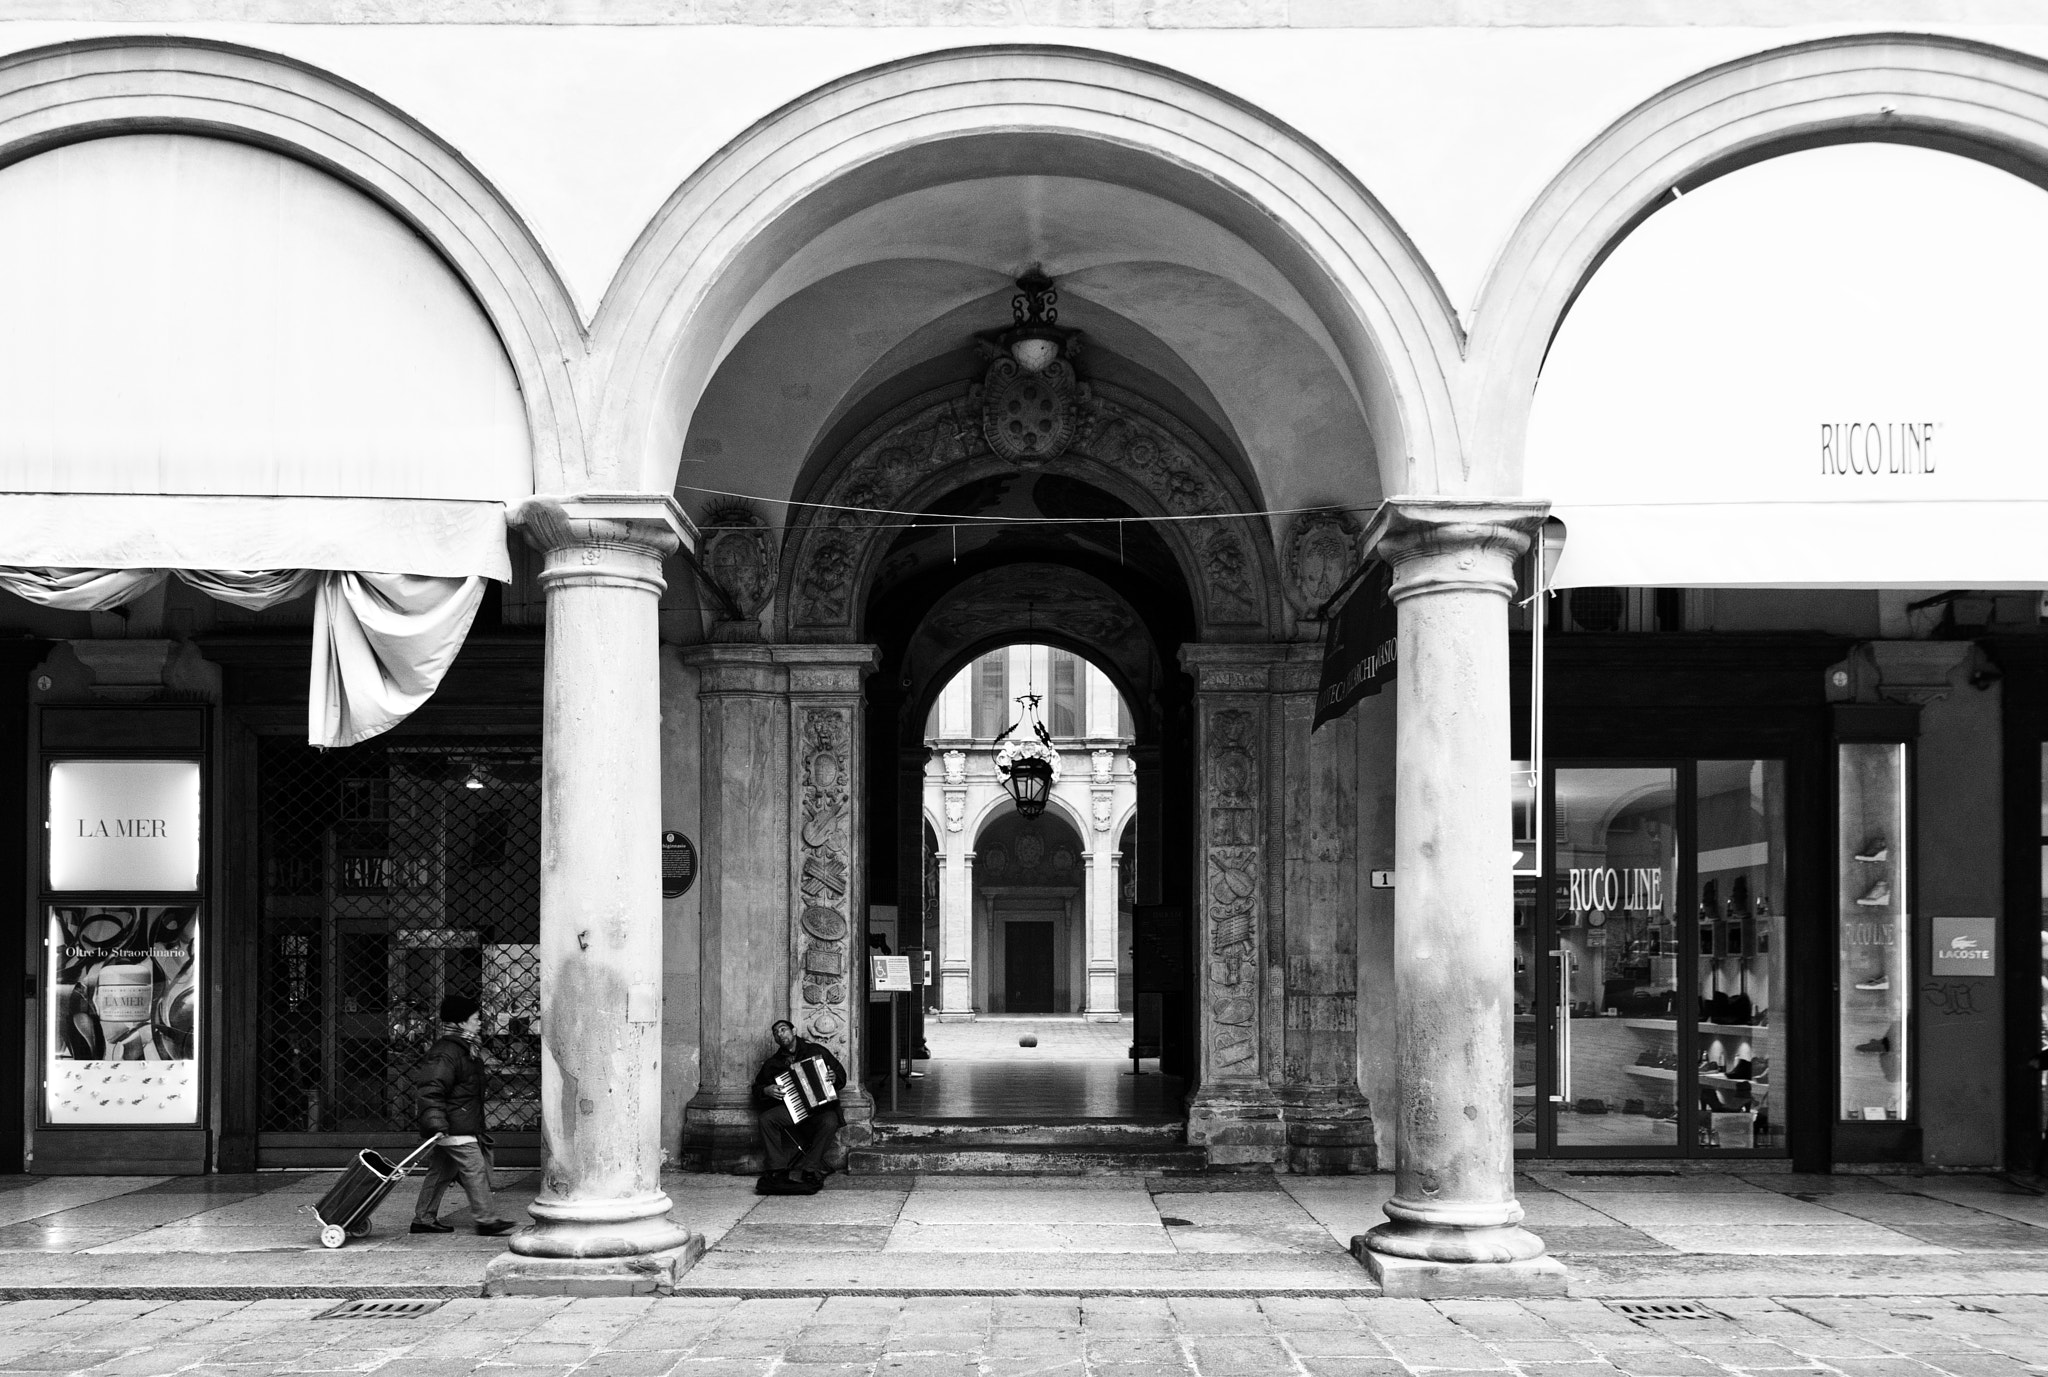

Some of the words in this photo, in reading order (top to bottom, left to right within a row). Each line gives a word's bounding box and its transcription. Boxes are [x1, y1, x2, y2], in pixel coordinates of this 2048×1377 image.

[1821, 422, 1882, 475] RUCO
[1888, 422, 1936, 475] LINE
[76, 819, 110, 838] LA
[115, 819, 168, 838] MER
[1382, 872, 1388, 886] 1
[1569, 866, 1619, 911] RUCO
[1623, 867, 1664, 911] LINE
[65, 946, 95, 958] Oltre
[97, 946, 109, 957] lo
[111, 946, 186, 958] Straordinario
[1939, 949, 1990, 959] LACOSTE
